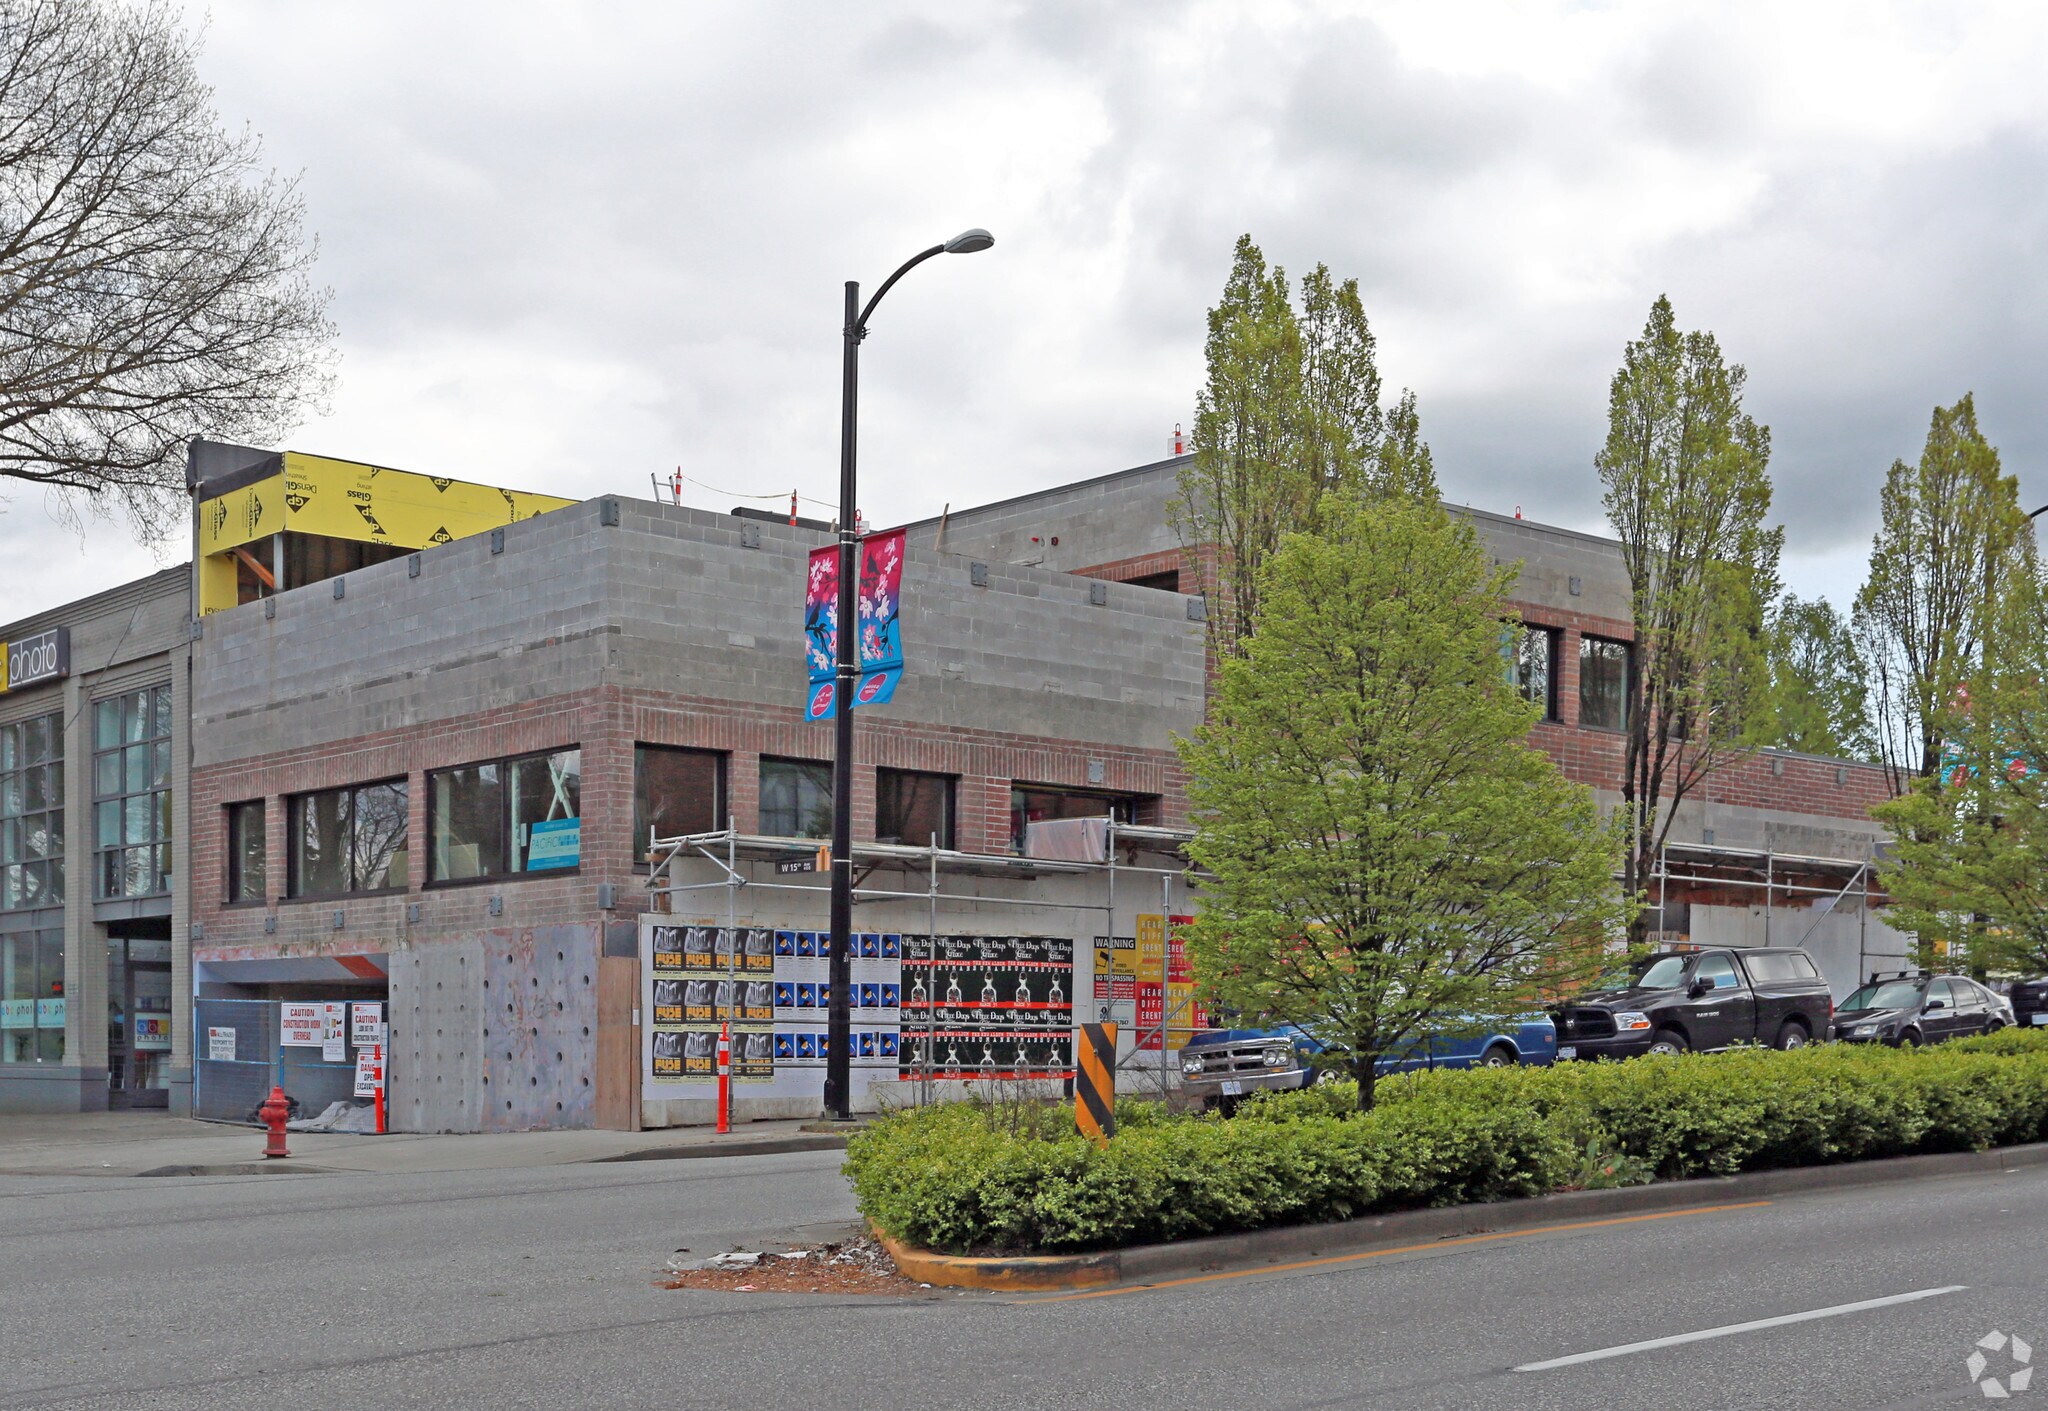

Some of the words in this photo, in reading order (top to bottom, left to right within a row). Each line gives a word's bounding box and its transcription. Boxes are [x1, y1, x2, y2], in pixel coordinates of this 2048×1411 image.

[434, 533, 450, 542] GP
[10, 635, 57, 685] photo
[782, 864, 788, 872] W
[1142, 932, 1161, 940] DIFF
[1096, 939, 1134, 948] WANING
[1168, 944, 1184, 953] EREN
[1141, 988, 1162, 997] HEAR
[1142, 1000, 1162, 1008] DIFF
[290, 1008, 315, 1017] CAUTION
[1142, 1012, 1161, 1020] ERENT
[283, 1020, 309, 1028] CONSTRUCTION
[355, 1015, 378, 1024] CAUTION
[138, 1022, 168, 1033] abc
[293, 1032, 311, 1040] OVERHEAD
